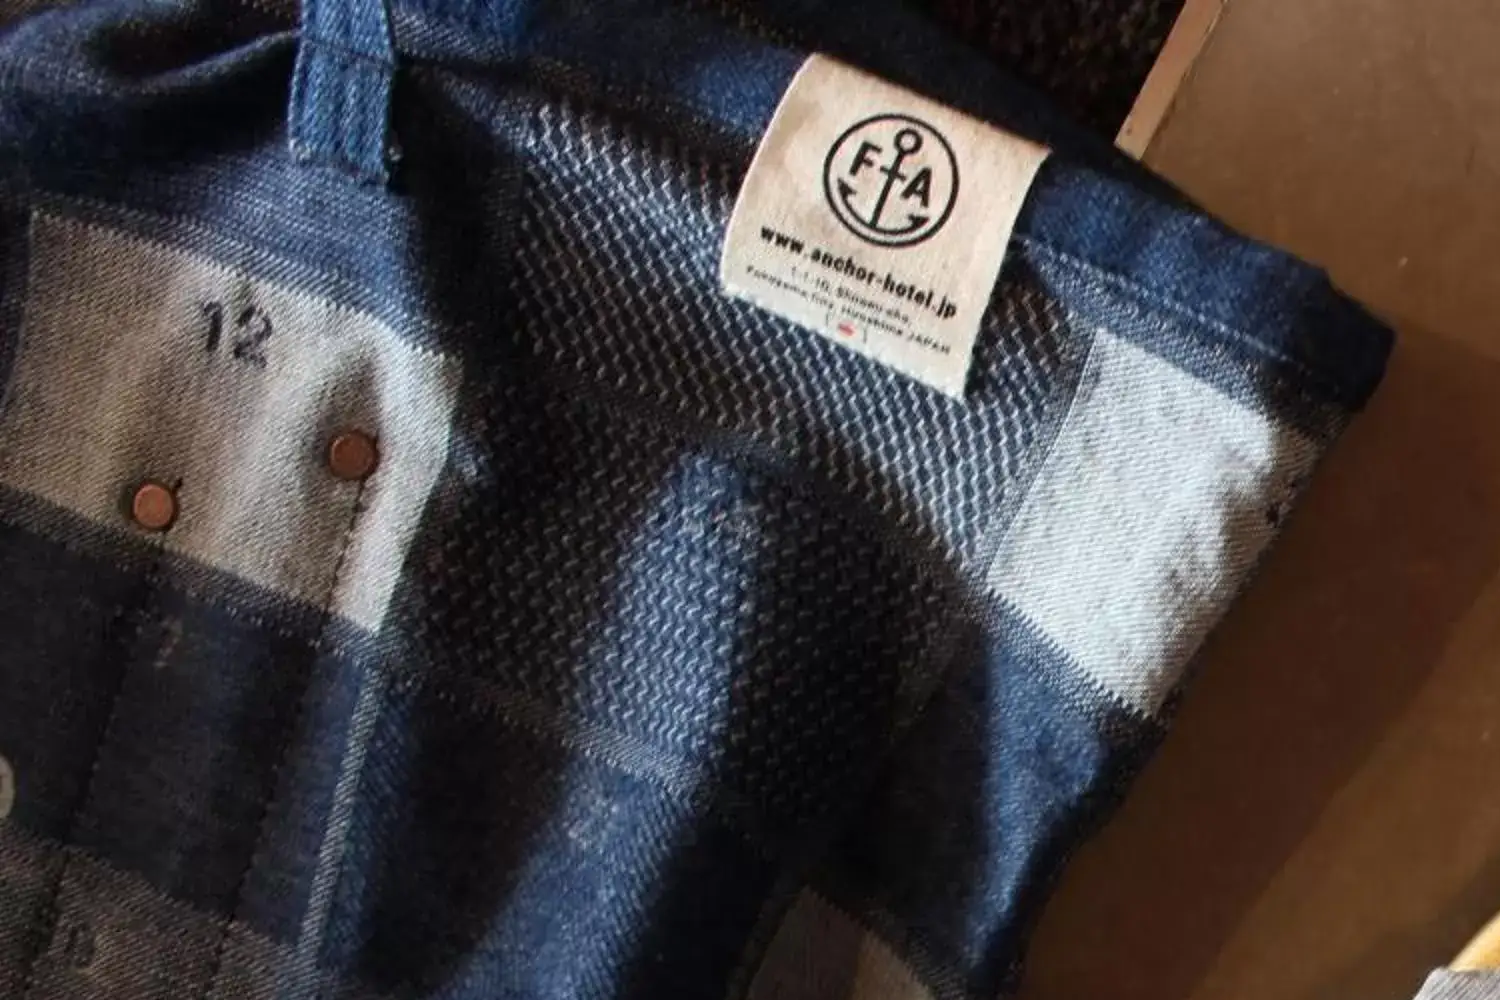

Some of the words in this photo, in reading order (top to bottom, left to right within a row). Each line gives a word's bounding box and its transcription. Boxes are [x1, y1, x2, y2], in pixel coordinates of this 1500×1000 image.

[849, 141, 883, 176] F
[901, 166, 932, 208] A
[760, 226, 958, 320] www.anchor-hotel.jp
[200, 301, 273, 369] 12
